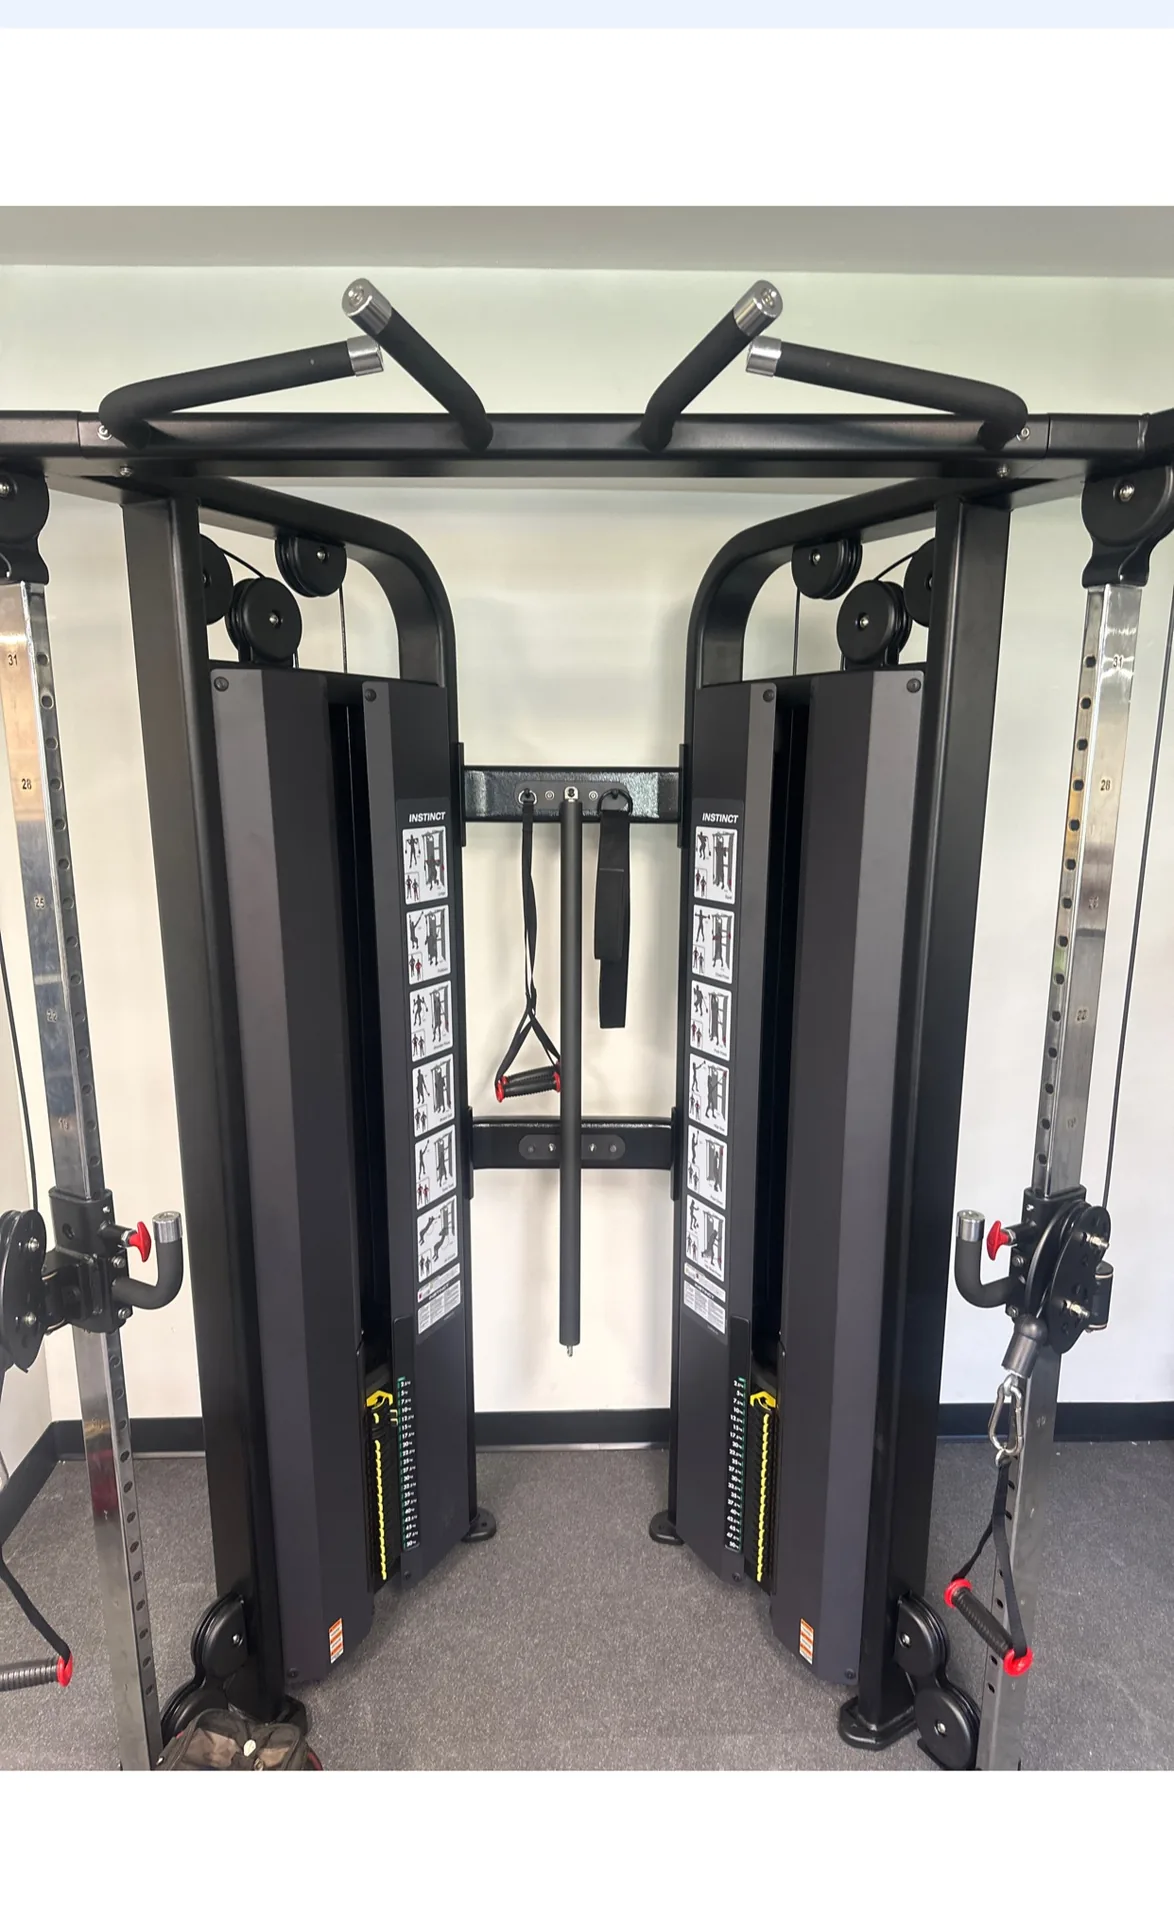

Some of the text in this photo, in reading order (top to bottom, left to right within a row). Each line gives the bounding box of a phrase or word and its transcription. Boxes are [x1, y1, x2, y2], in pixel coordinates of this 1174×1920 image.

[8, 654, 18, 666] 31
[1113, 654, 1123, 667] 31
[22, 778, 32, 790] 28
[1100, 779, 1110, 791] 28
[409, 811, 446, 823] INSTINCT
[702, 812, 739, 824] INSTINCT
[34, 896, 45, 908] 25
